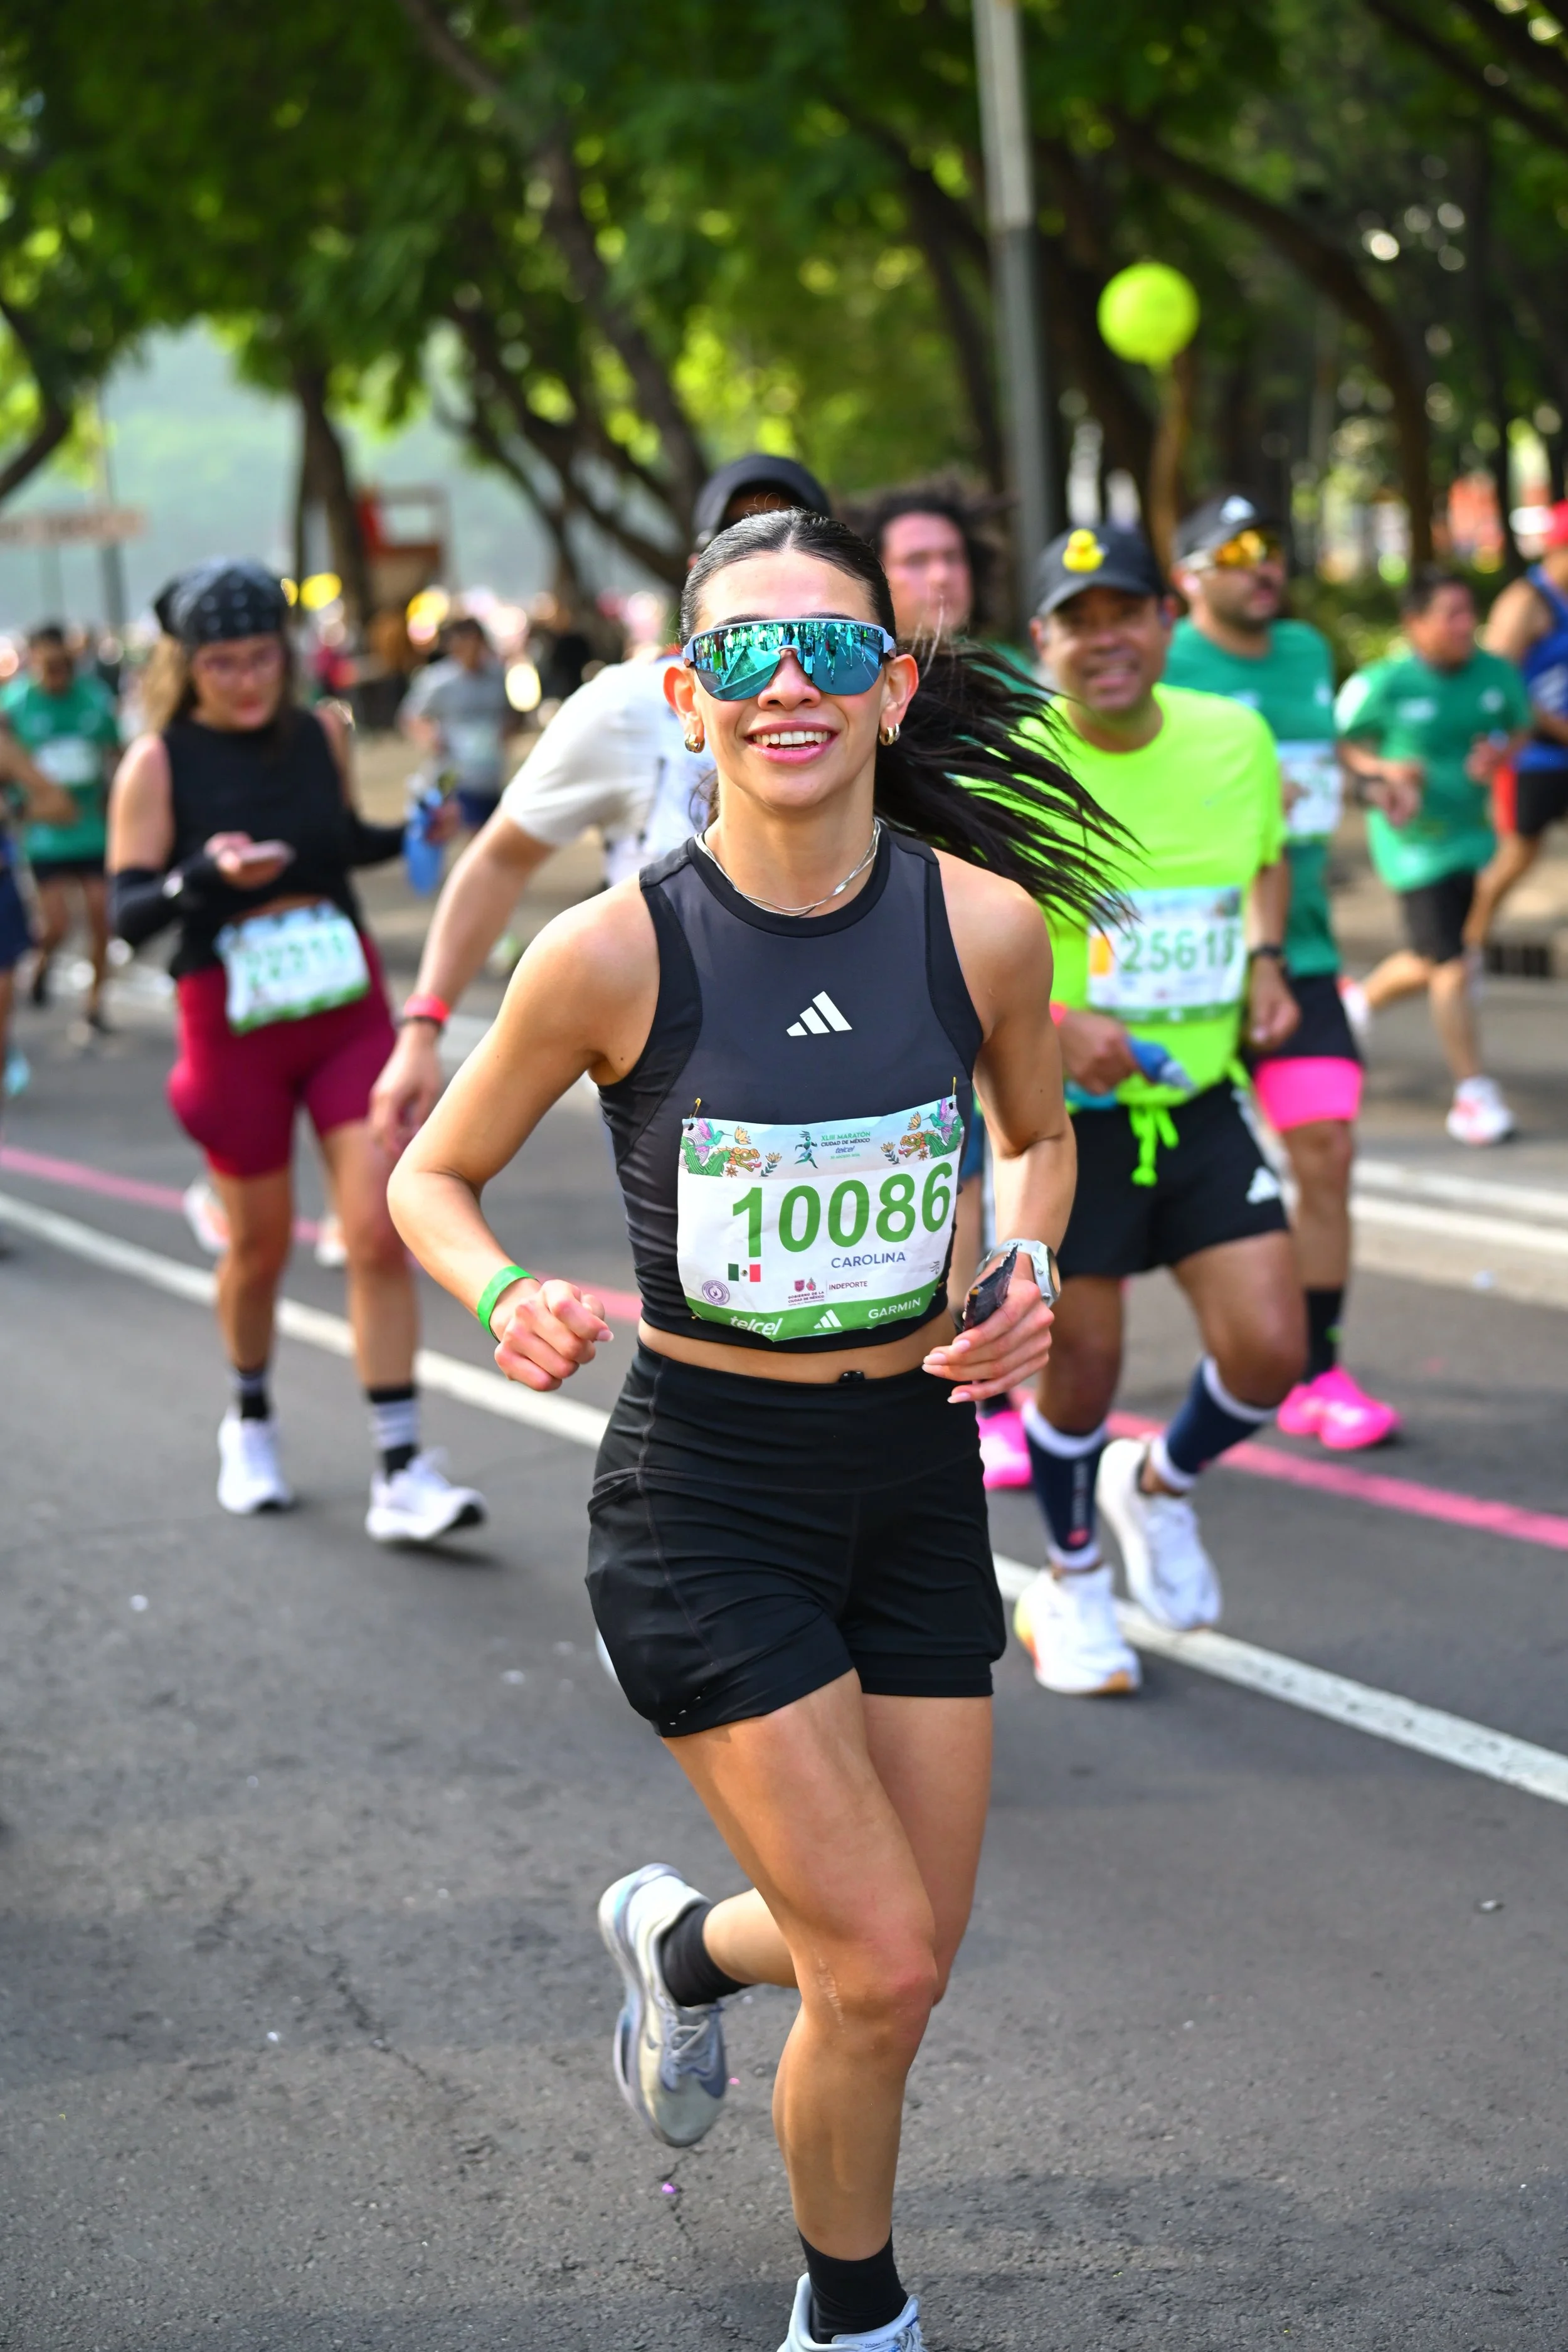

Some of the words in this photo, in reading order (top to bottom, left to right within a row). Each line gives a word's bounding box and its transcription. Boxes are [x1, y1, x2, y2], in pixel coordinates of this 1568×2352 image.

[733, 1162, 953, 1258] 10086
[831, 1251, 906, 1268] CAROLINA
[829, 1281, 868, 1290] INDEPORTE
[868, 1297, 921, 1319] GARMIN
[730, 1316, 783, 1335] telcel
